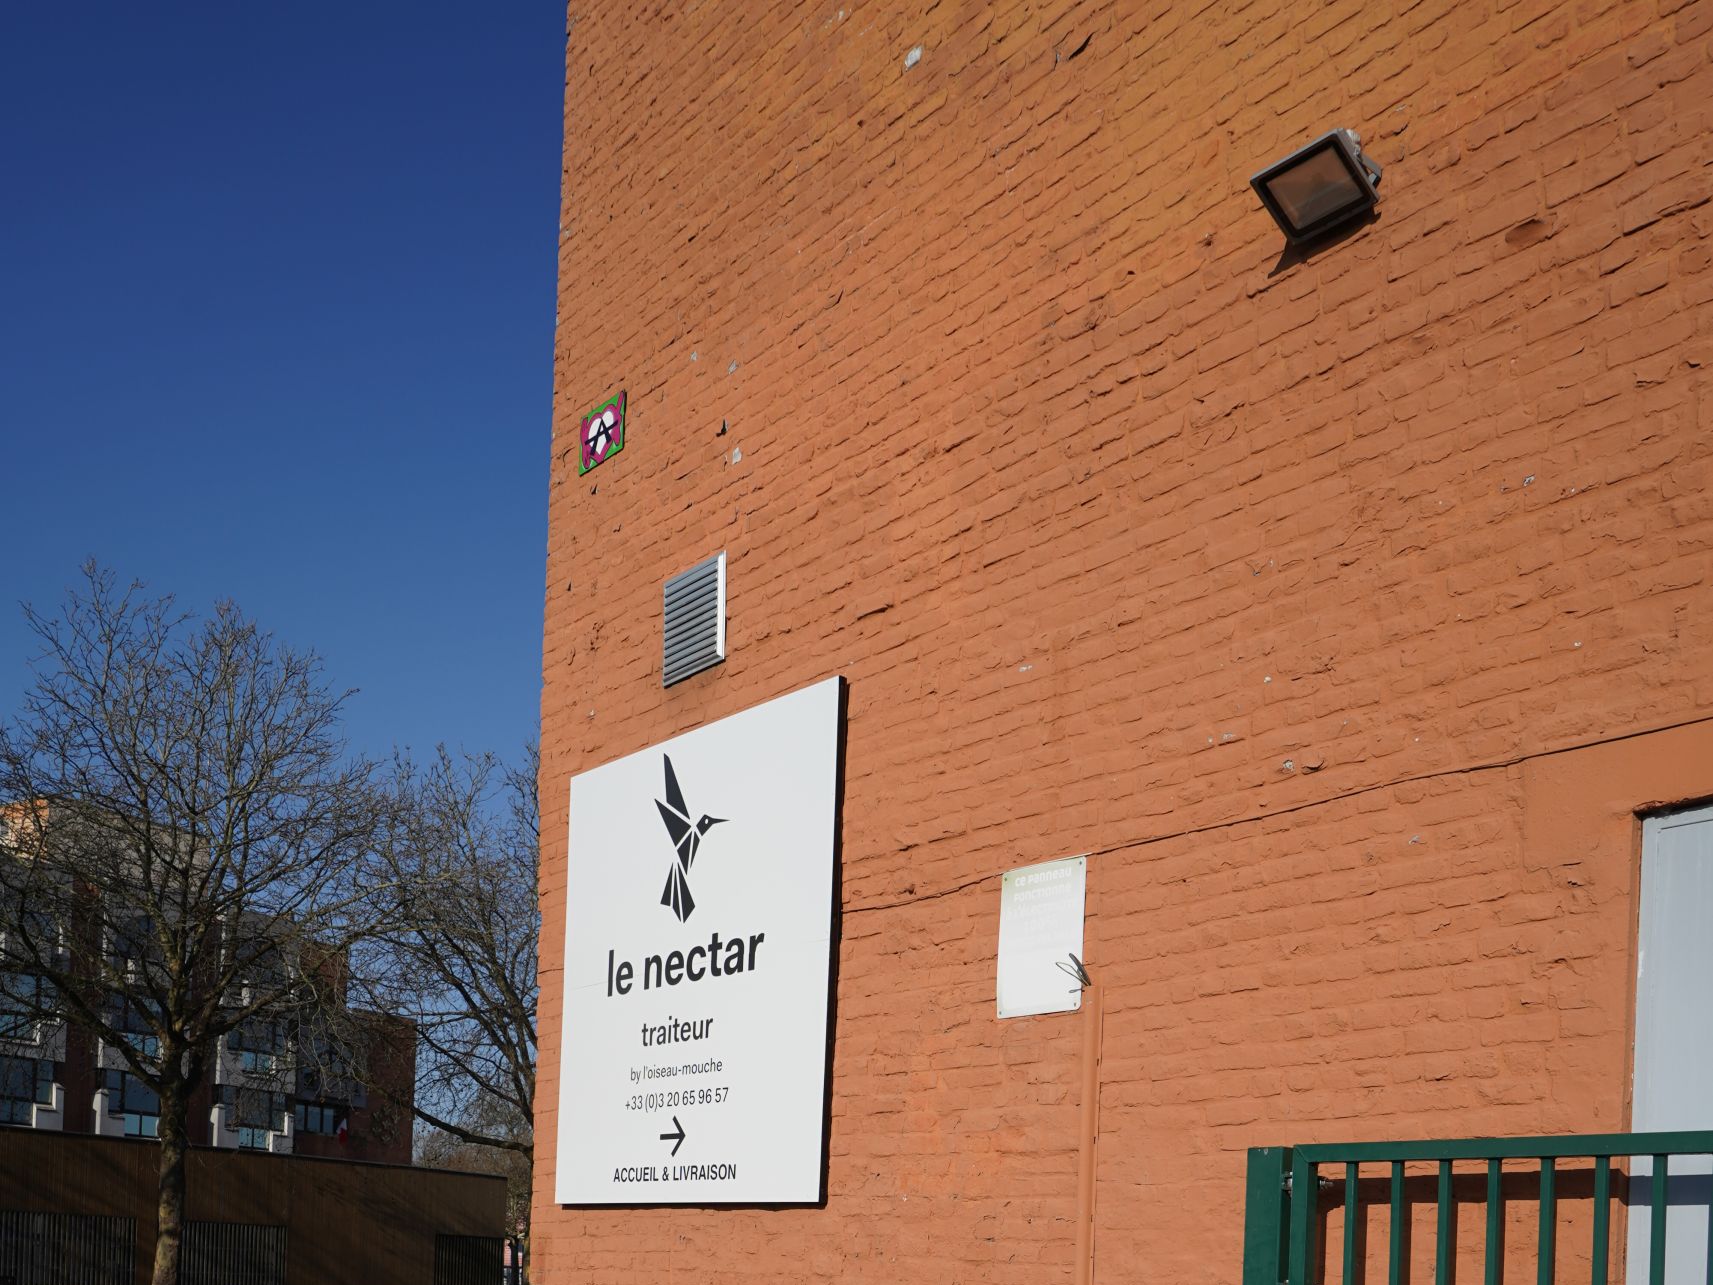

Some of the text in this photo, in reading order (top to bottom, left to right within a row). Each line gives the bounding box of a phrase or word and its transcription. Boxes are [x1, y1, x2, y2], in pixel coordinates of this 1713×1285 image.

[607, 932, 765, 997] le nectar
[641, 1015, 714, 1047] traiteur
[630, 1058, 723, 1084] by l'oiseau-mouche
[625, 1087, 729, 1113] +33 (0)3 20 65 96 57
[613, 1164, 737, 1183] ACCUEIL & LIVRAISON
